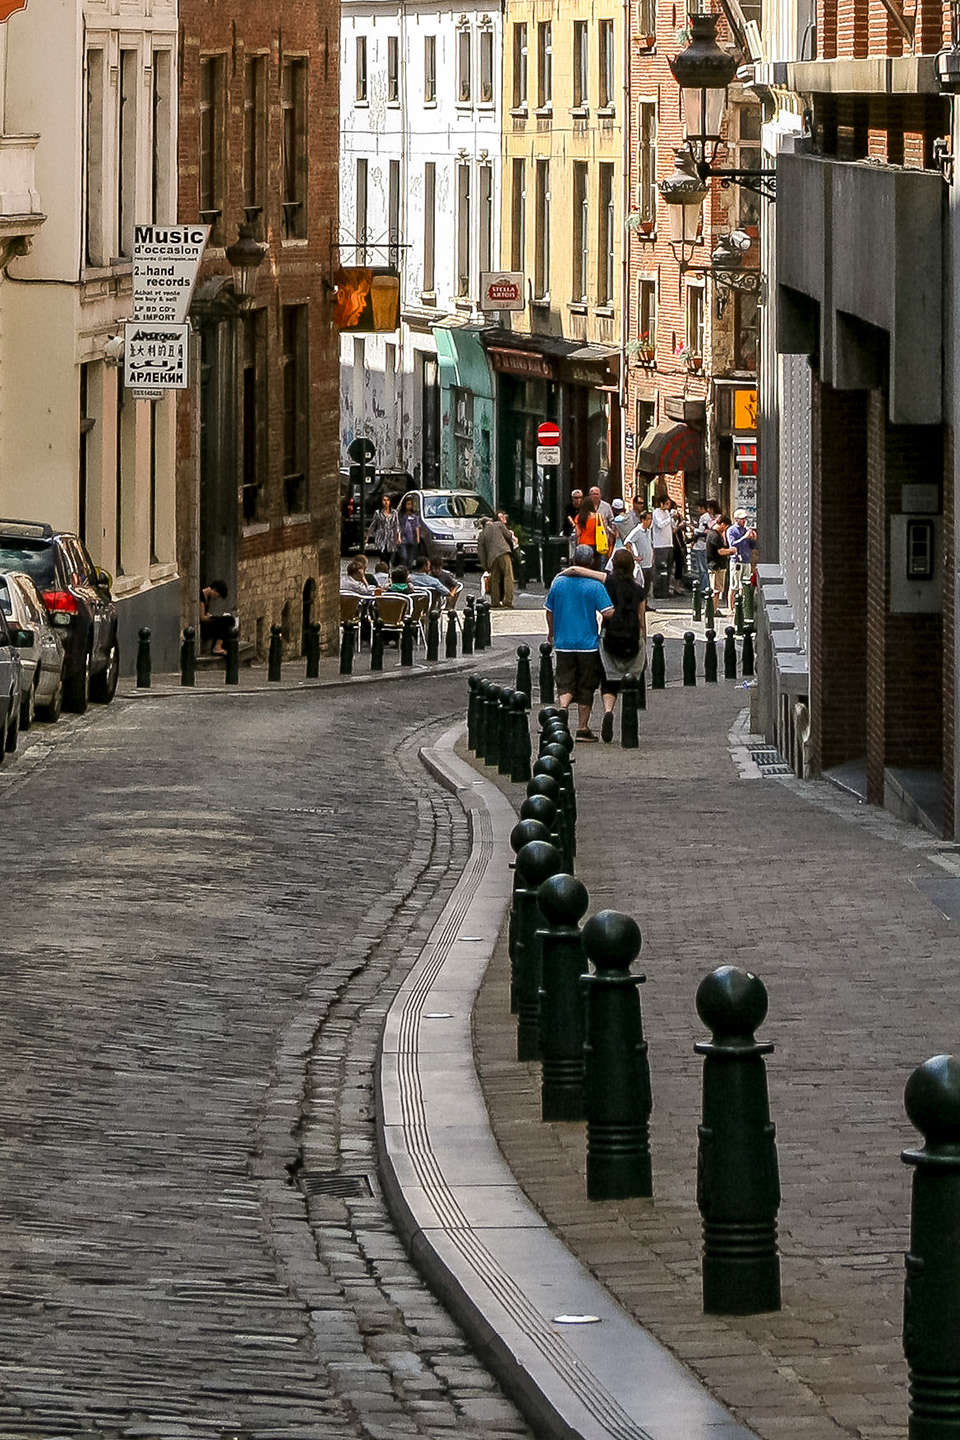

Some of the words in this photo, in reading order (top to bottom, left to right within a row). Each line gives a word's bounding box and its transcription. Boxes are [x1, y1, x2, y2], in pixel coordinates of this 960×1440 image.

[135, 226, 204, 244] Music
[134, 245, 199, 255] d'occasion
[146, 276, 191, 287] records
[143, 313, 176, 321] IMPORT
[129, 371, 183, 383] АРЛЕКИН
